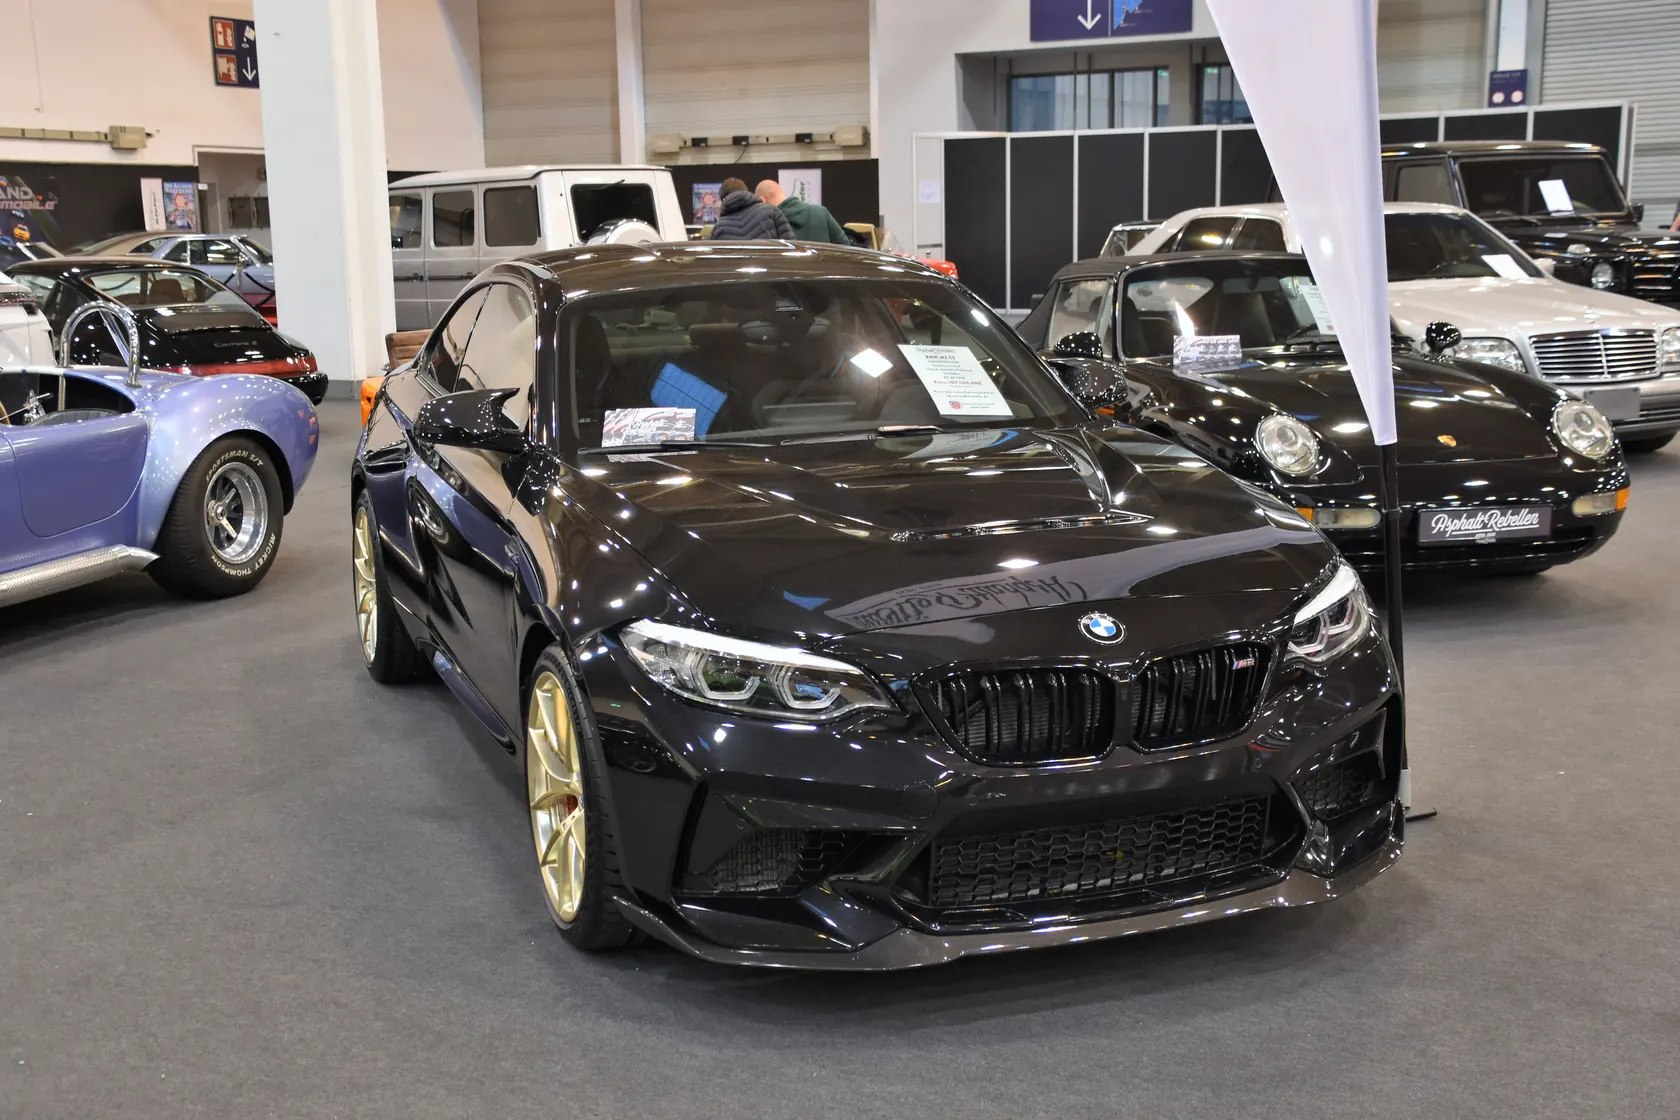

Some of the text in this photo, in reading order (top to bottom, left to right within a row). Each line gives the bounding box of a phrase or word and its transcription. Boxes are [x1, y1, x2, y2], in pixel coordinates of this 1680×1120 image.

[205, 450, 264, 483] SPORTSMAN S/T
[1431, 508, 1540, 537] Asphalt Rebellen
[211, 532, 276, 578] MICKEY THOMPSON
